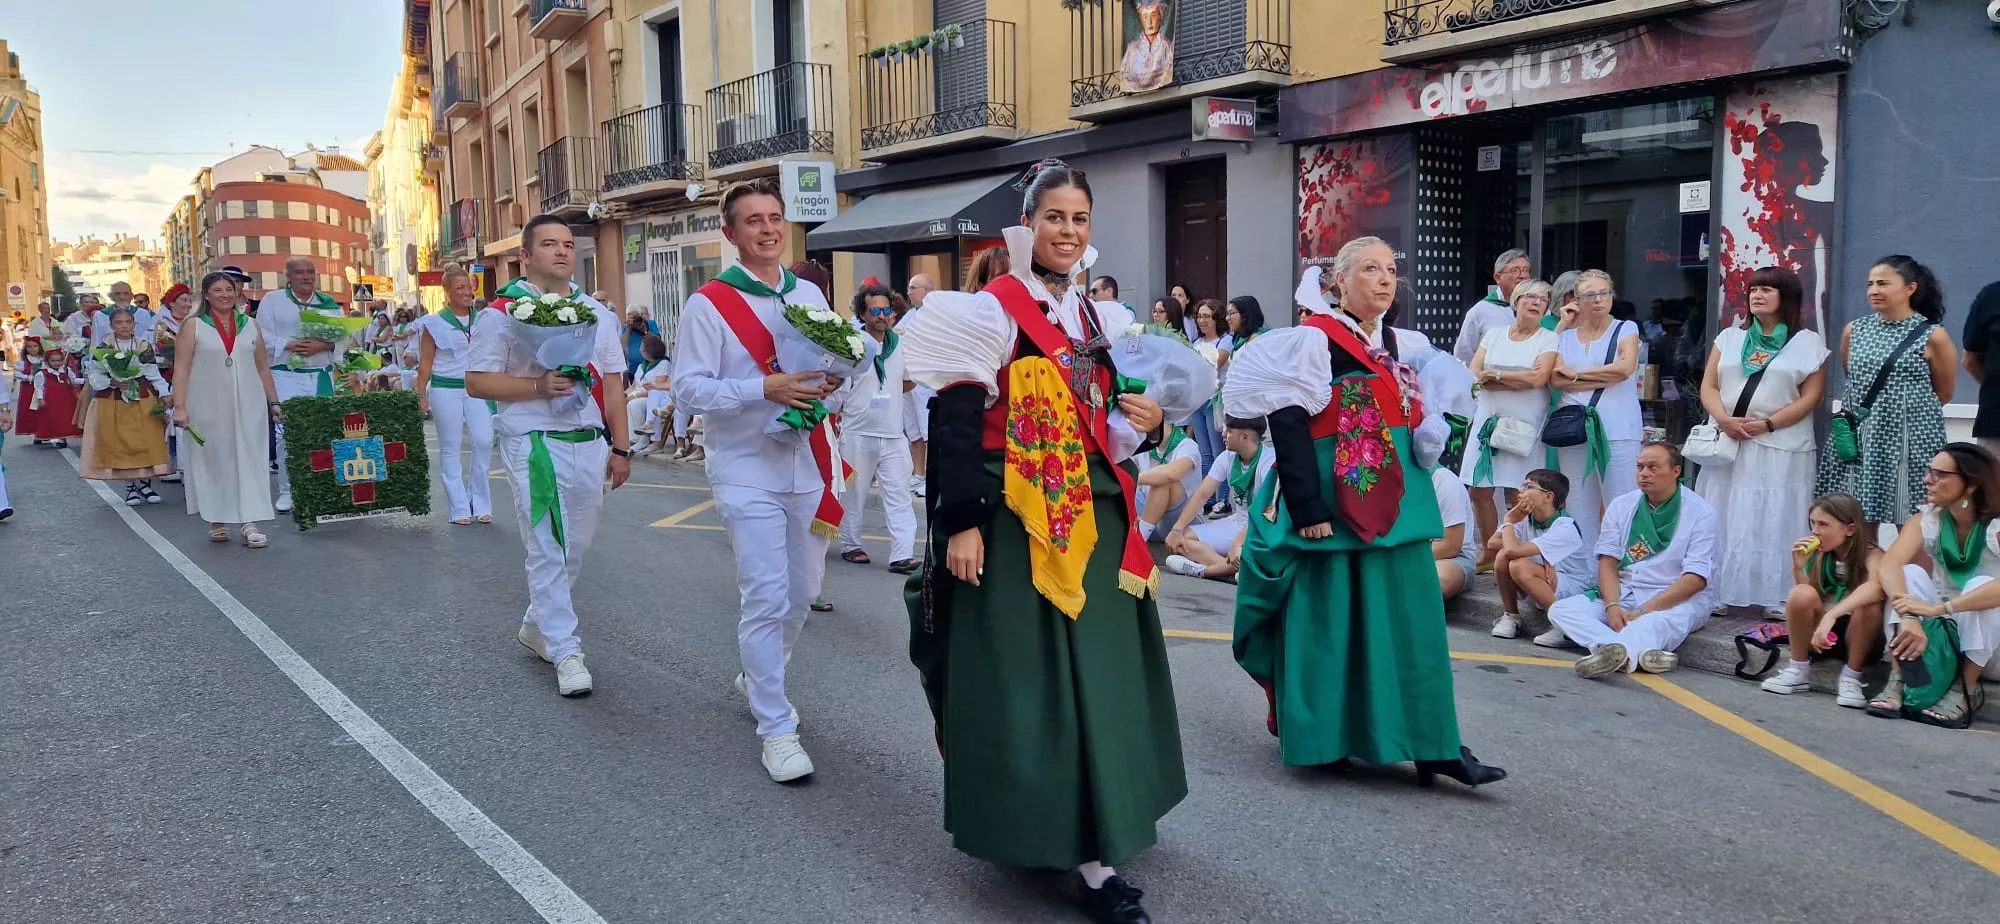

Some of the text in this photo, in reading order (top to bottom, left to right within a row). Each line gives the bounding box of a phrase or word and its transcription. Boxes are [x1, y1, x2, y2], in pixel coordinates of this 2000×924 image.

[793, 194, 830, 207] Aragón
[795, 206, 827, 216] Fincas
[647, 214, 721, 241] Aragón Fincas
